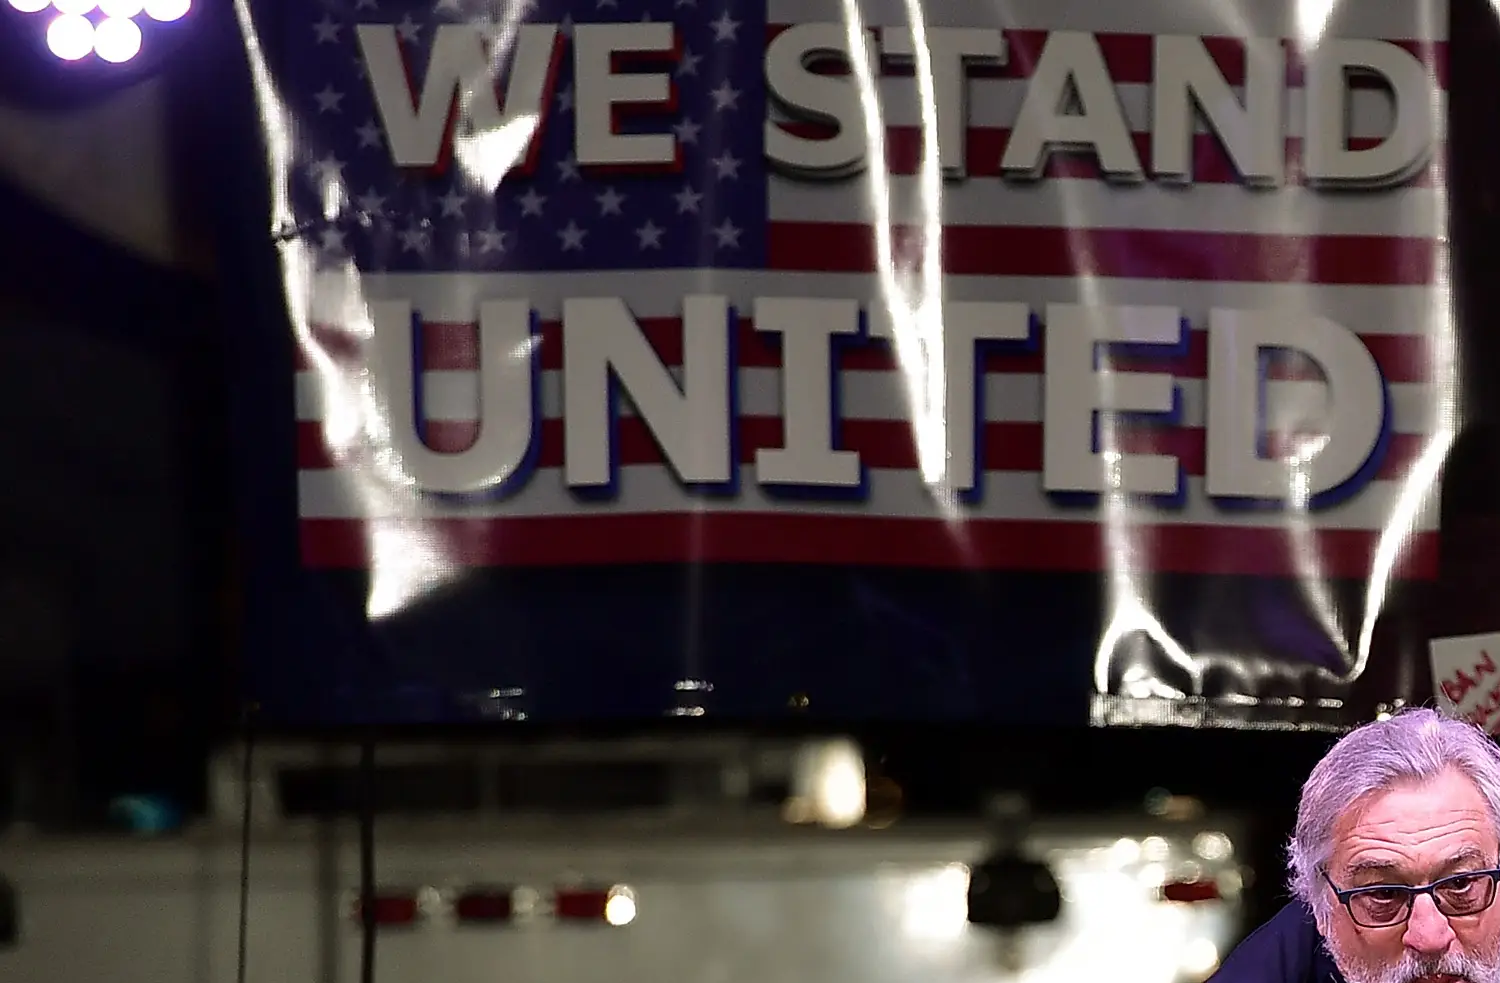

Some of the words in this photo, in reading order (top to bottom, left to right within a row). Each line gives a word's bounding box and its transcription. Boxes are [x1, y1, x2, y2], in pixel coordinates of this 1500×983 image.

[357, 21, 683, 176] WE
[764, 21, 1437, 190] STAND
[371, 294, 1393, 511] UNITED
